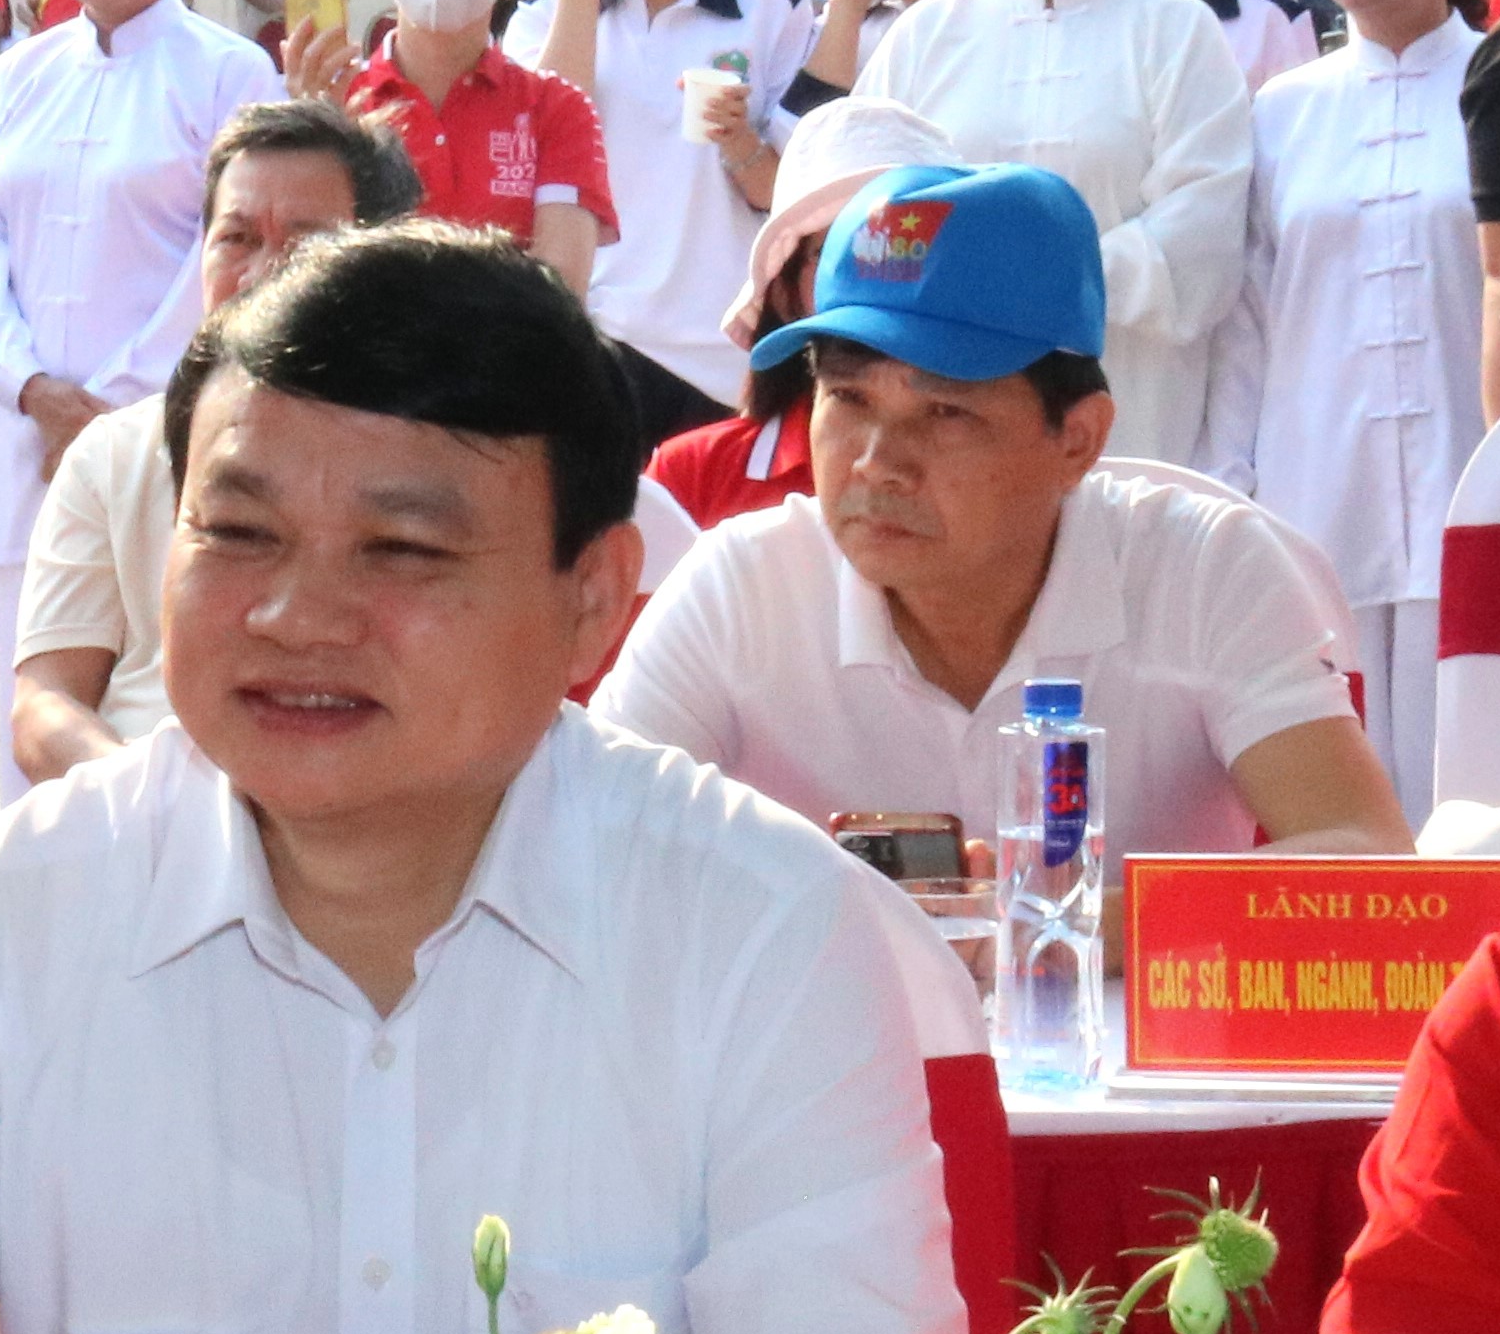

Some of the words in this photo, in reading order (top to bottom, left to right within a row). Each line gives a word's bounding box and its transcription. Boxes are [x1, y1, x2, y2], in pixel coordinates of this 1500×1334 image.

[1247, 885, 1351, 919] LÃNH
[1366, 893, 1450, 925] ĐẠO
[1149, 949, 1193, 1010] CÁC
[1239, 960, 1291, 1016] BAN,
[1296, 949, 1379, 1016] NGÀNH,
